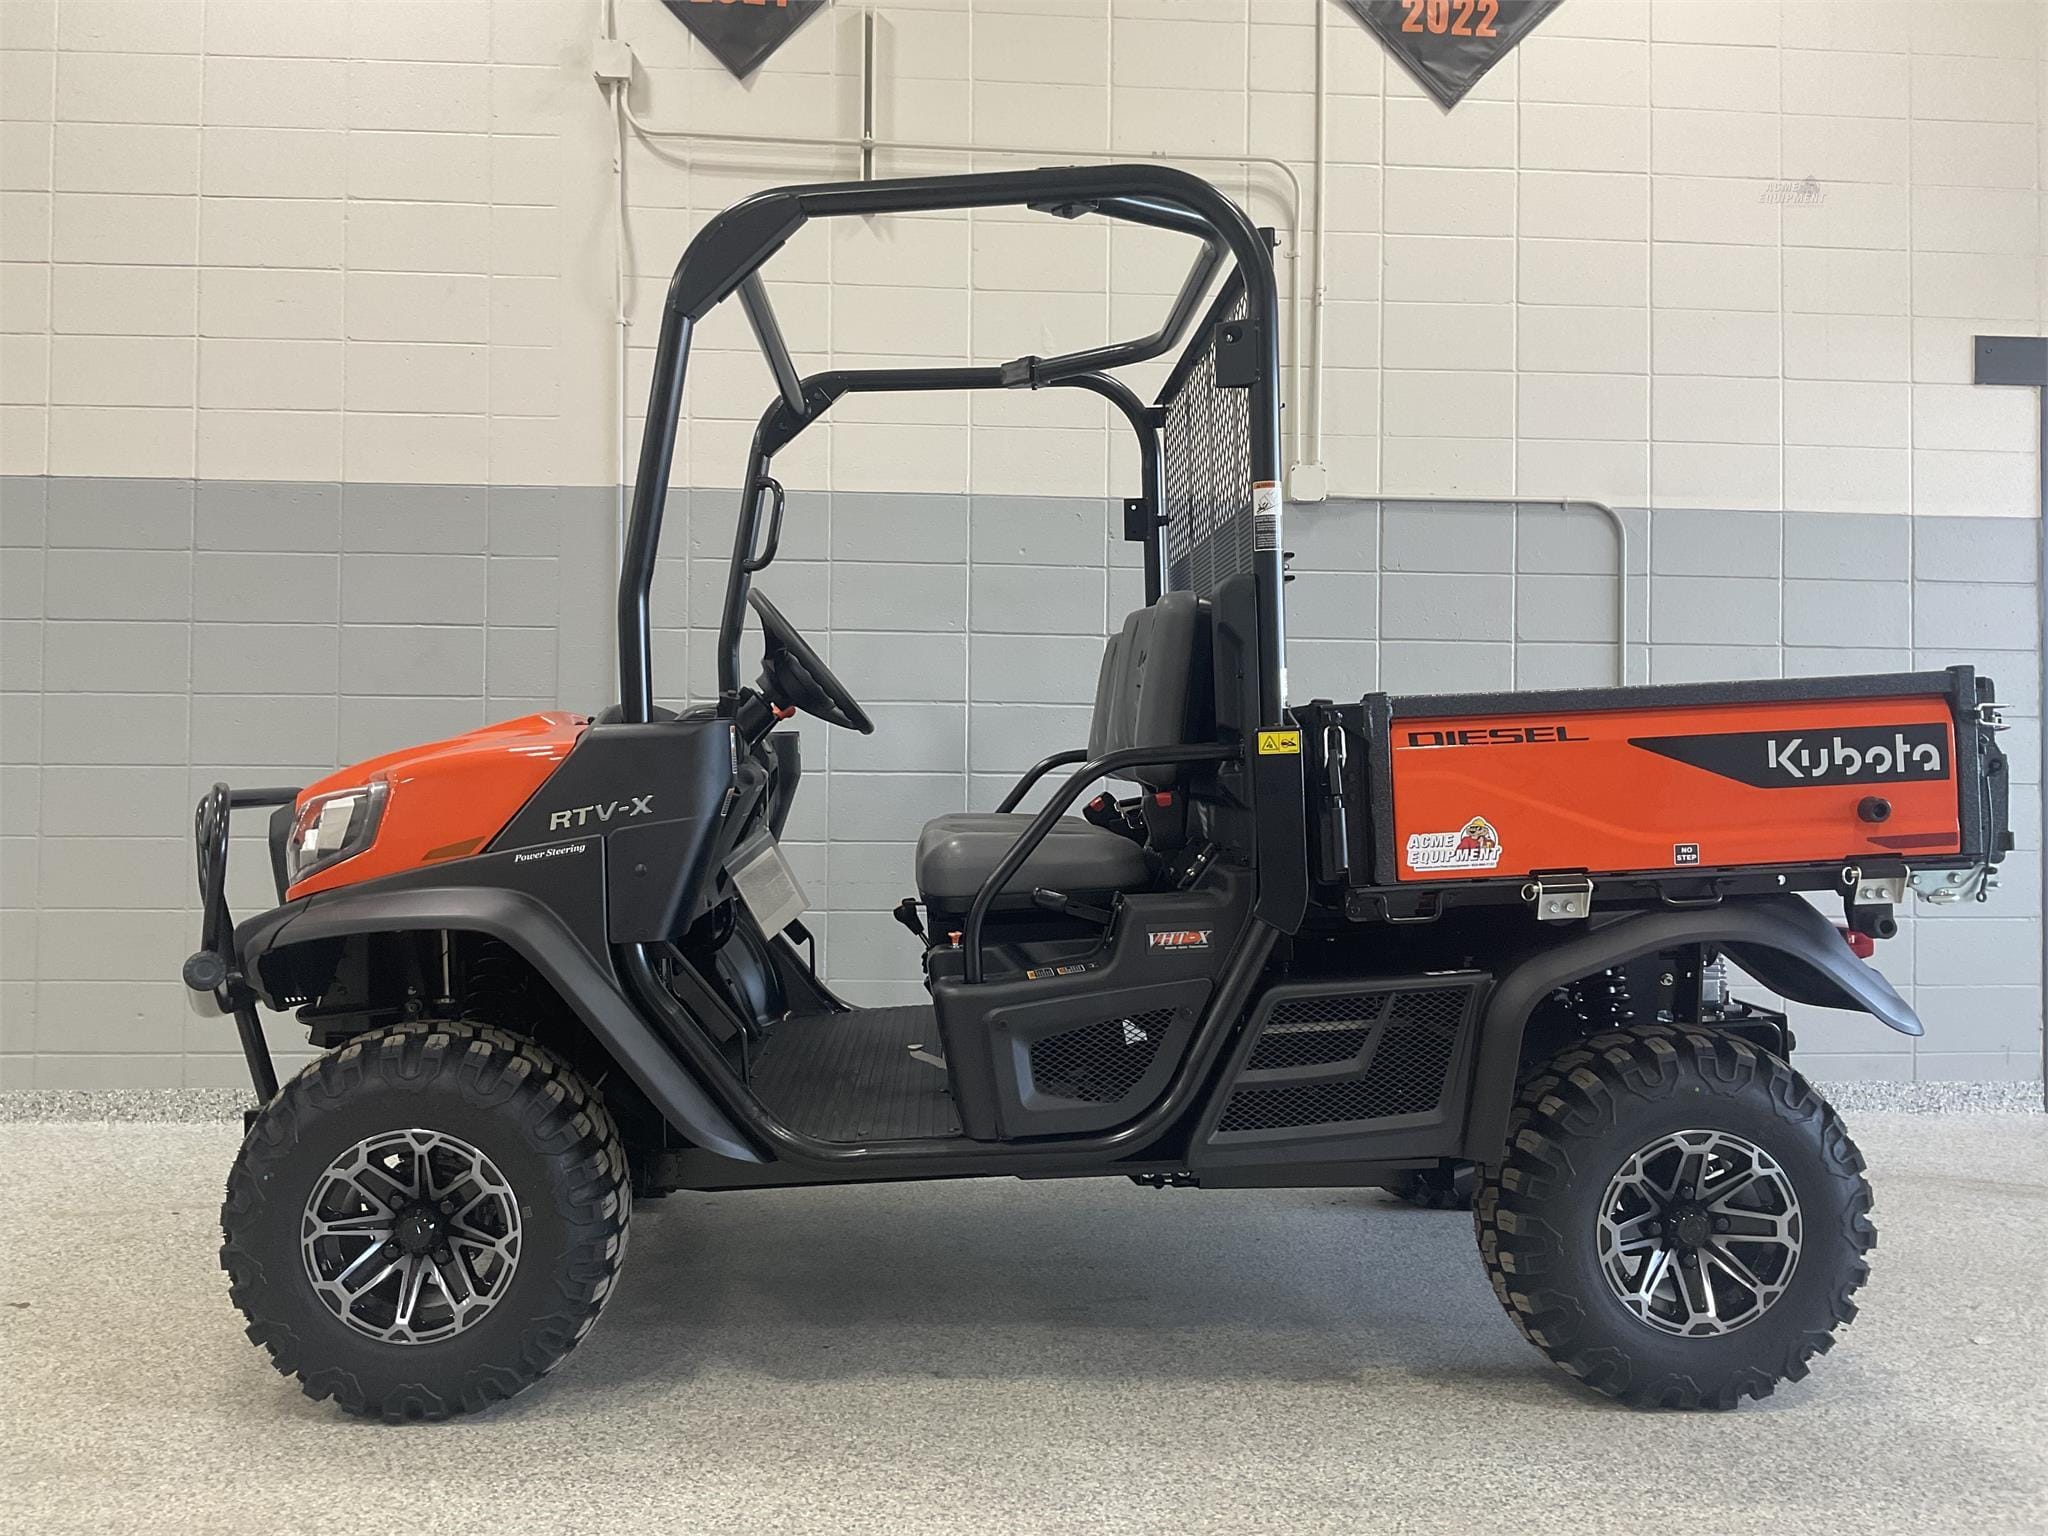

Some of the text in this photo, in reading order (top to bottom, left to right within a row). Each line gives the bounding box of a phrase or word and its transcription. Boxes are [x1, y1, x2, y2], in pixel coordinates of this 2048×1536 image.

[1402, 0, 1499, 37] 2022
[1408, 726, 1590, 747] DIESEL
[1767, 733, 1941, 778] Kubota
[549, 794, 655, 832] RTV-X
[1409, 834, 1454, 849] ACME
[514, 844, 586, 863] Power Steering
[1409, 847, 1500, 865] EQUIPMENT
